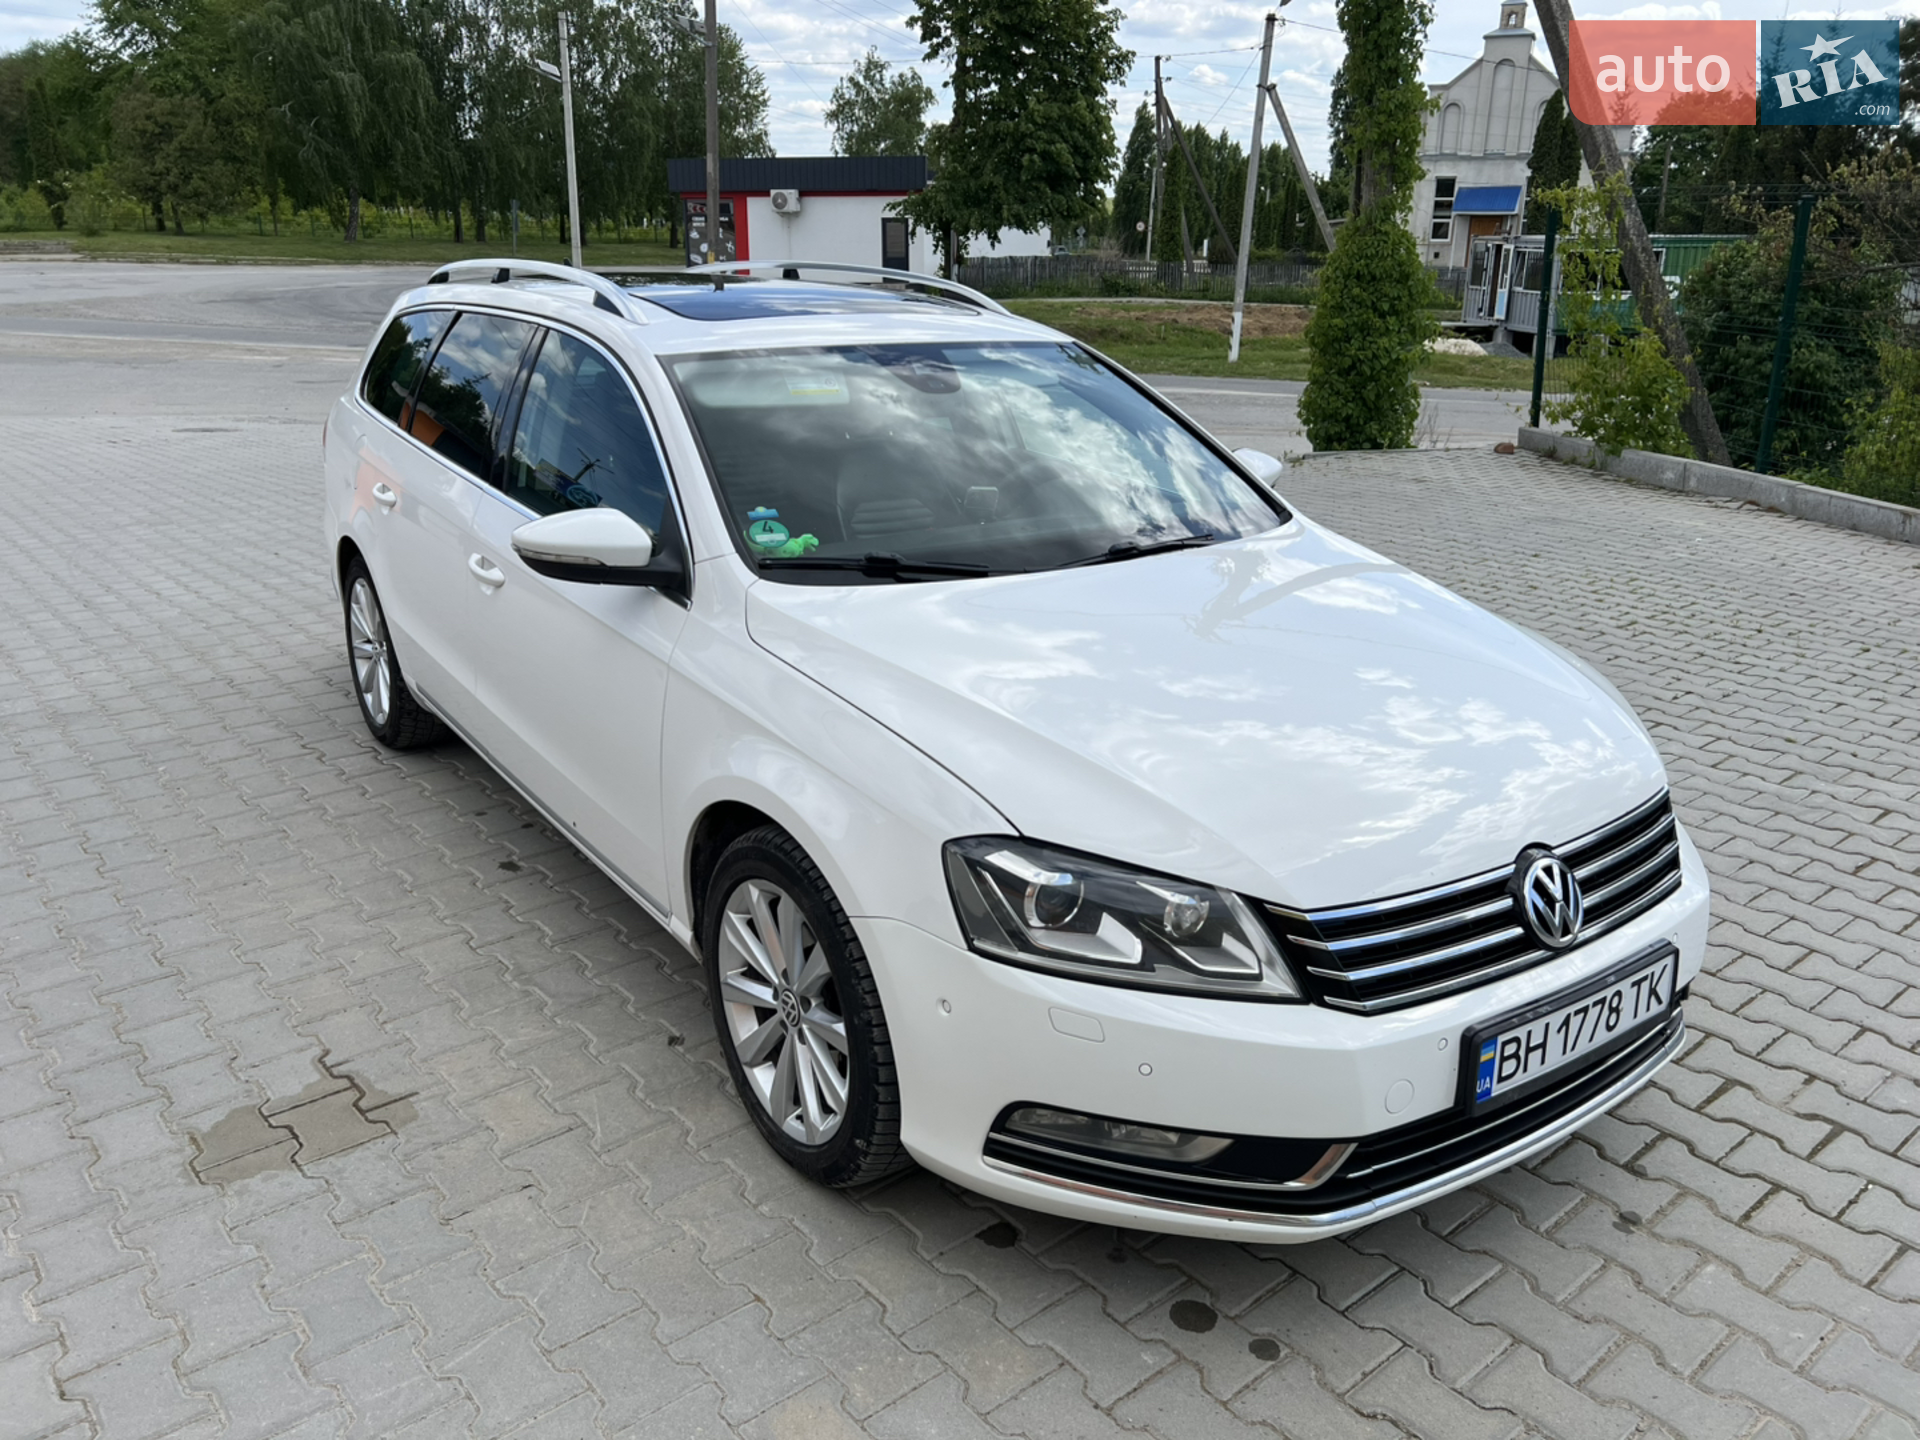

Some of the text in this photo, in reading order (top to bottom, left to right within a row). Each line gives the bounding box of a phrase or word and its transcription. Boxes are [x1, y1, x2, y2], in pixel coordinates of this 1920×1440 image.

[1497, 963, 1668, 1085] BH 1778 TK
[1476, 1076, 1492, 1093] UA
